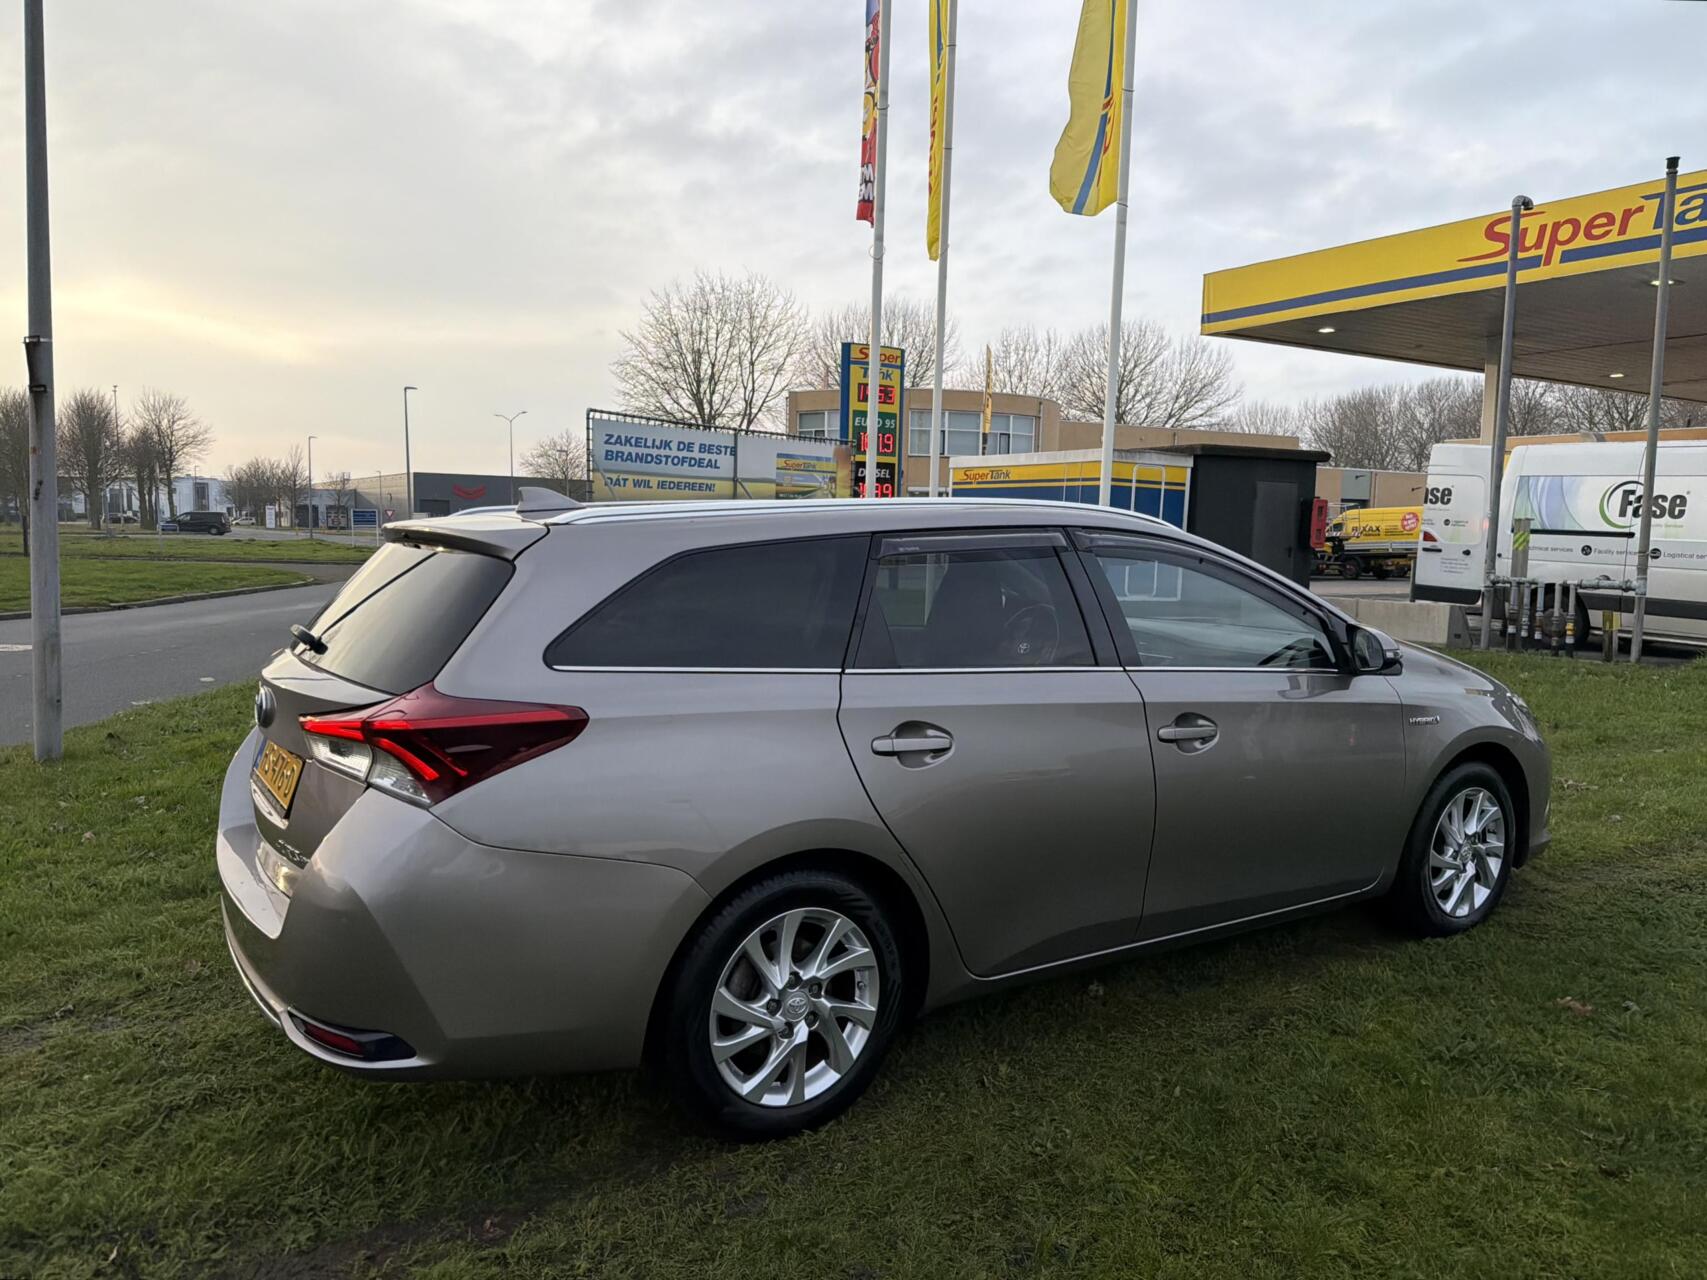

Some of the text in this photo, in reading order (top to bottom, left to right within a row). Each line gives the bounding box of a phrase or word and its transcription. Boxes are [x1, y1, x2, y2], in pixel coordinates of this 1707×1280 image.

[851, 347, 901, 363] Sper
[859, 367, 893, 381] Tnk
[854, 417, 896, 428] EUO 95
[604, 433, 737, 456] ZAKELIJK DE BESTE
[860, 432, 894, 453] 11.9
[604, 449, 721, 469] BRANDSTOFDEAL
[858, 468, 891, 478] DSEL
[961, 469, 1011, 485] SuperTank
[632, 479, 653, 489] WIL
[656, 480, 716, 492] IEDEREEN!
[1618, 489, 1688, 519] Fase
